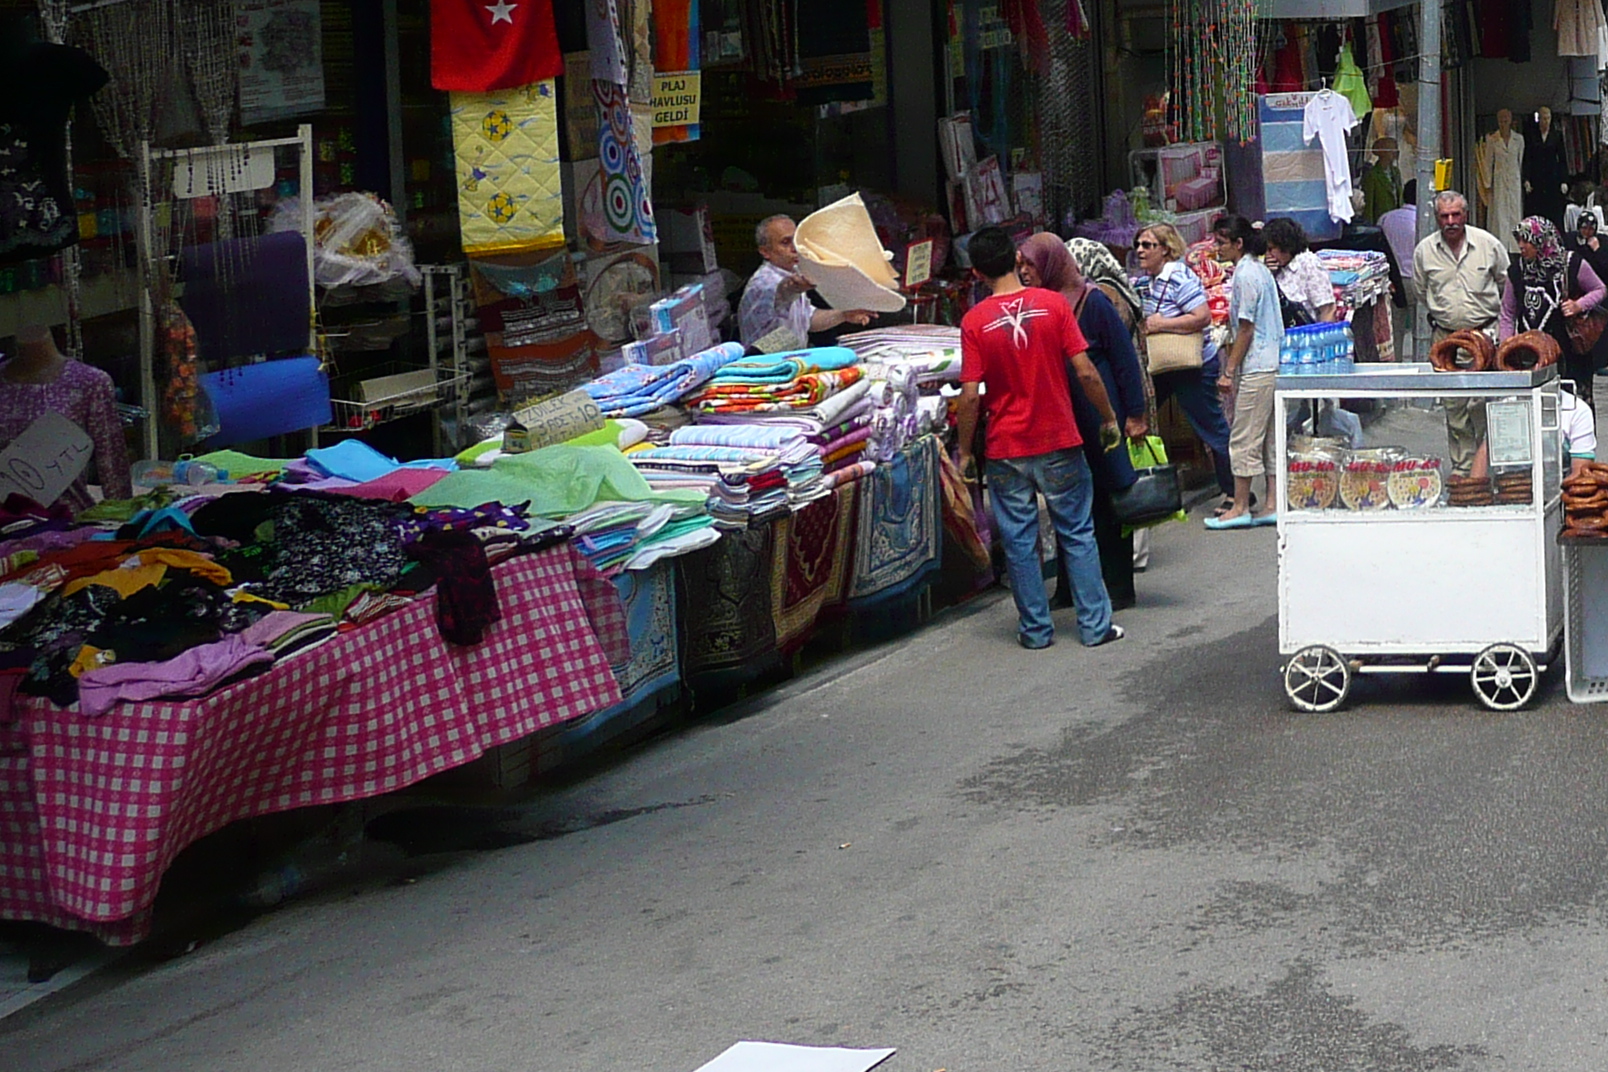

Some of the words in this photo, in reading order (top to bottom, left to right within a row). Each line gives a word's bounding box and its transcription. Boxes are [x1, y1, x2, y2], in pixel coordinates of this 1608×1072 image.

[661, 80, 686, 91] PLAJ
[650, 94, 696, 108] HAVLUSU
[655, 108, 690, 123] GELDİ
[46, 443, 89, 477] YTL
